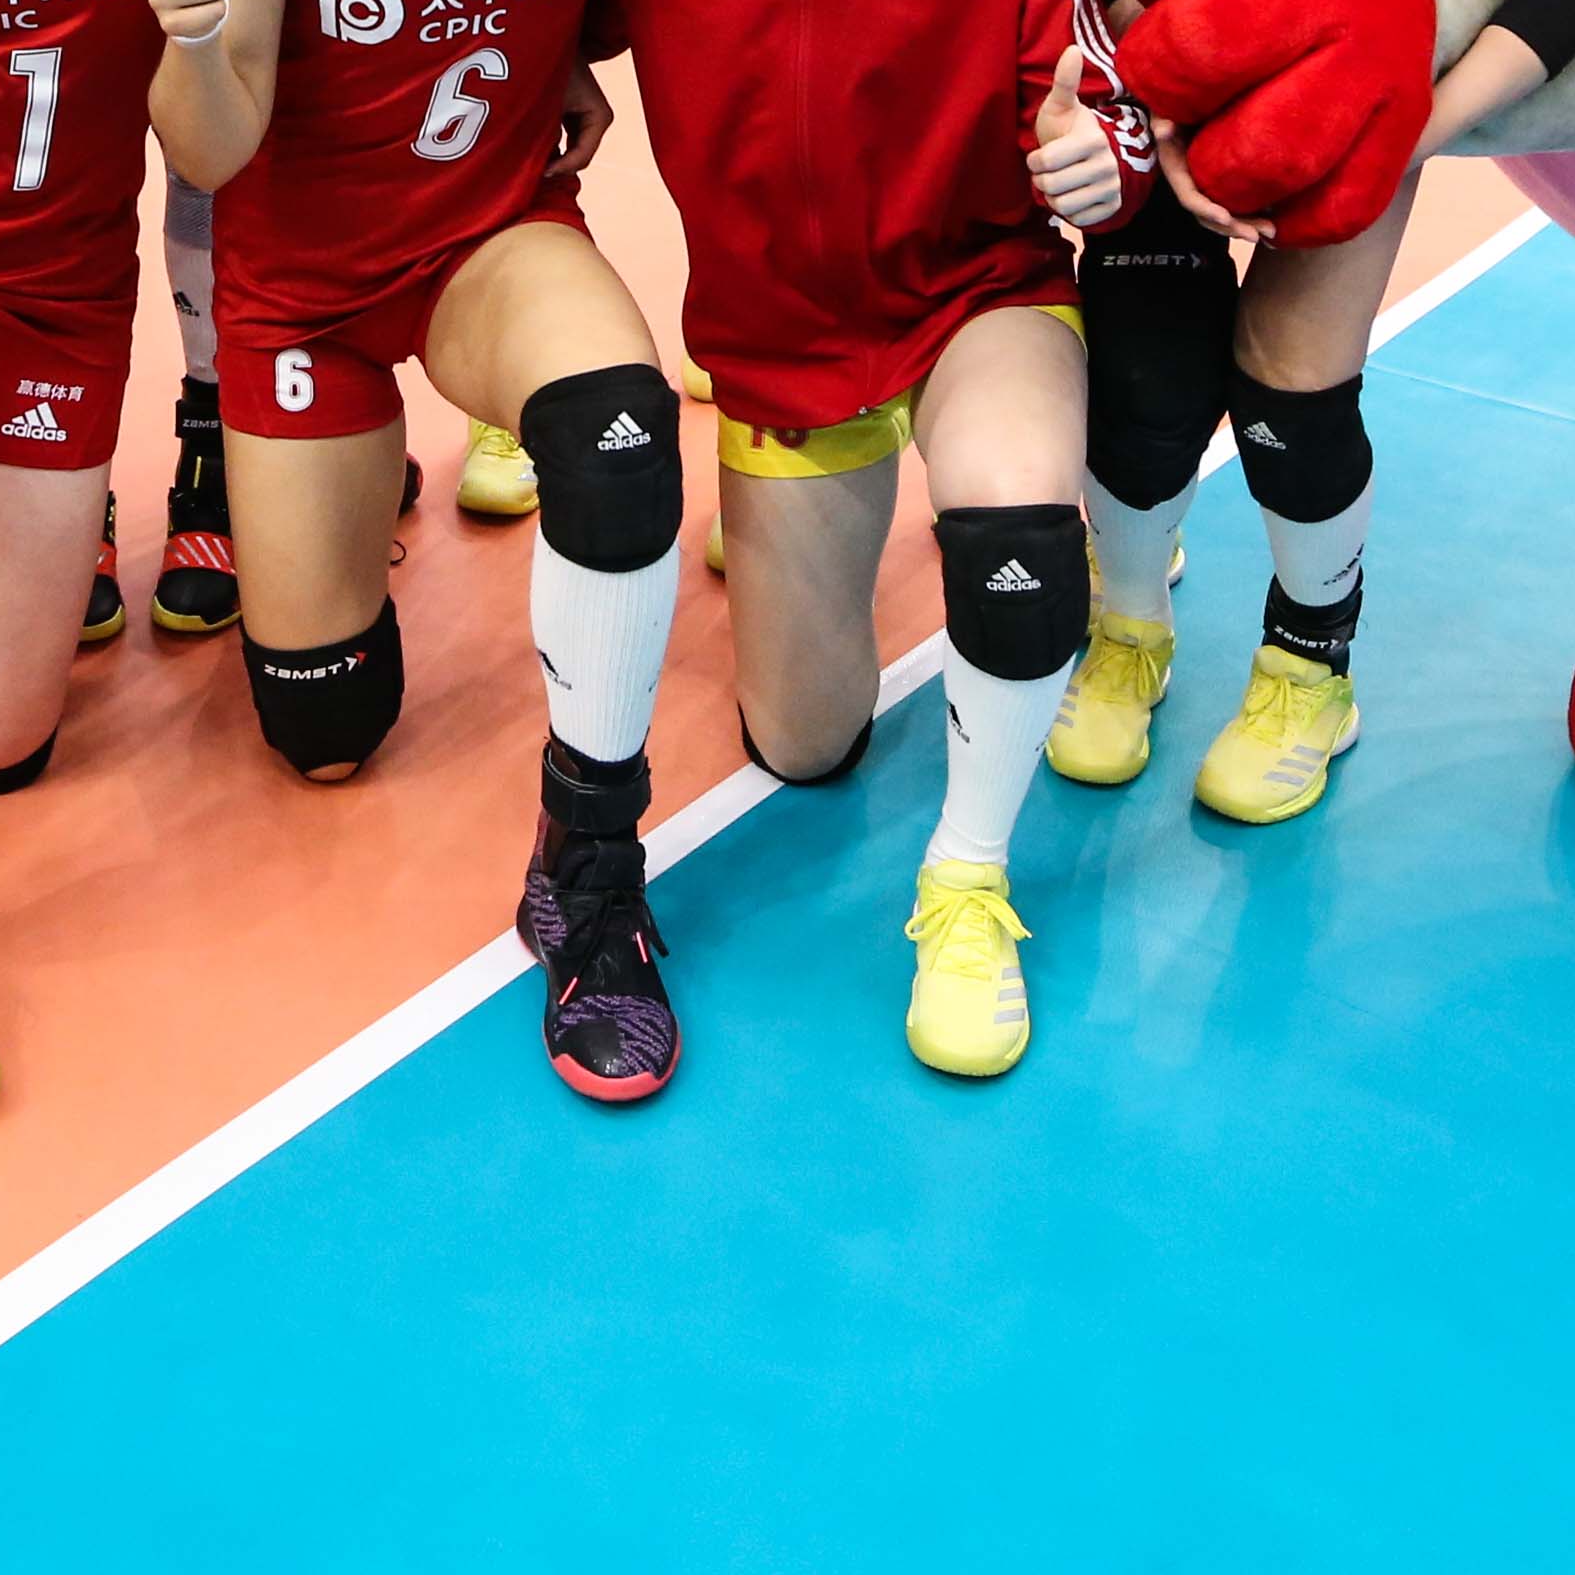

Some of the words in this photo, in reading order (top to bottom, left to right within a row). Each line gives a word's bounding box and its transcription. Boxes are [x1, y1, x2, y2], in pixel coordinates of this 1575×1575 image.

[419, 9, 507, 43] CPIC
[410, 47, 509, 161] 6
[275, 348, 314, 412] 6
[1, 422, 67, 442] adidas
[597, 432, 651, 451] adidas
[1243, 426, 1287, 451] adidas
[986, 578, 1042, 592] adidas
